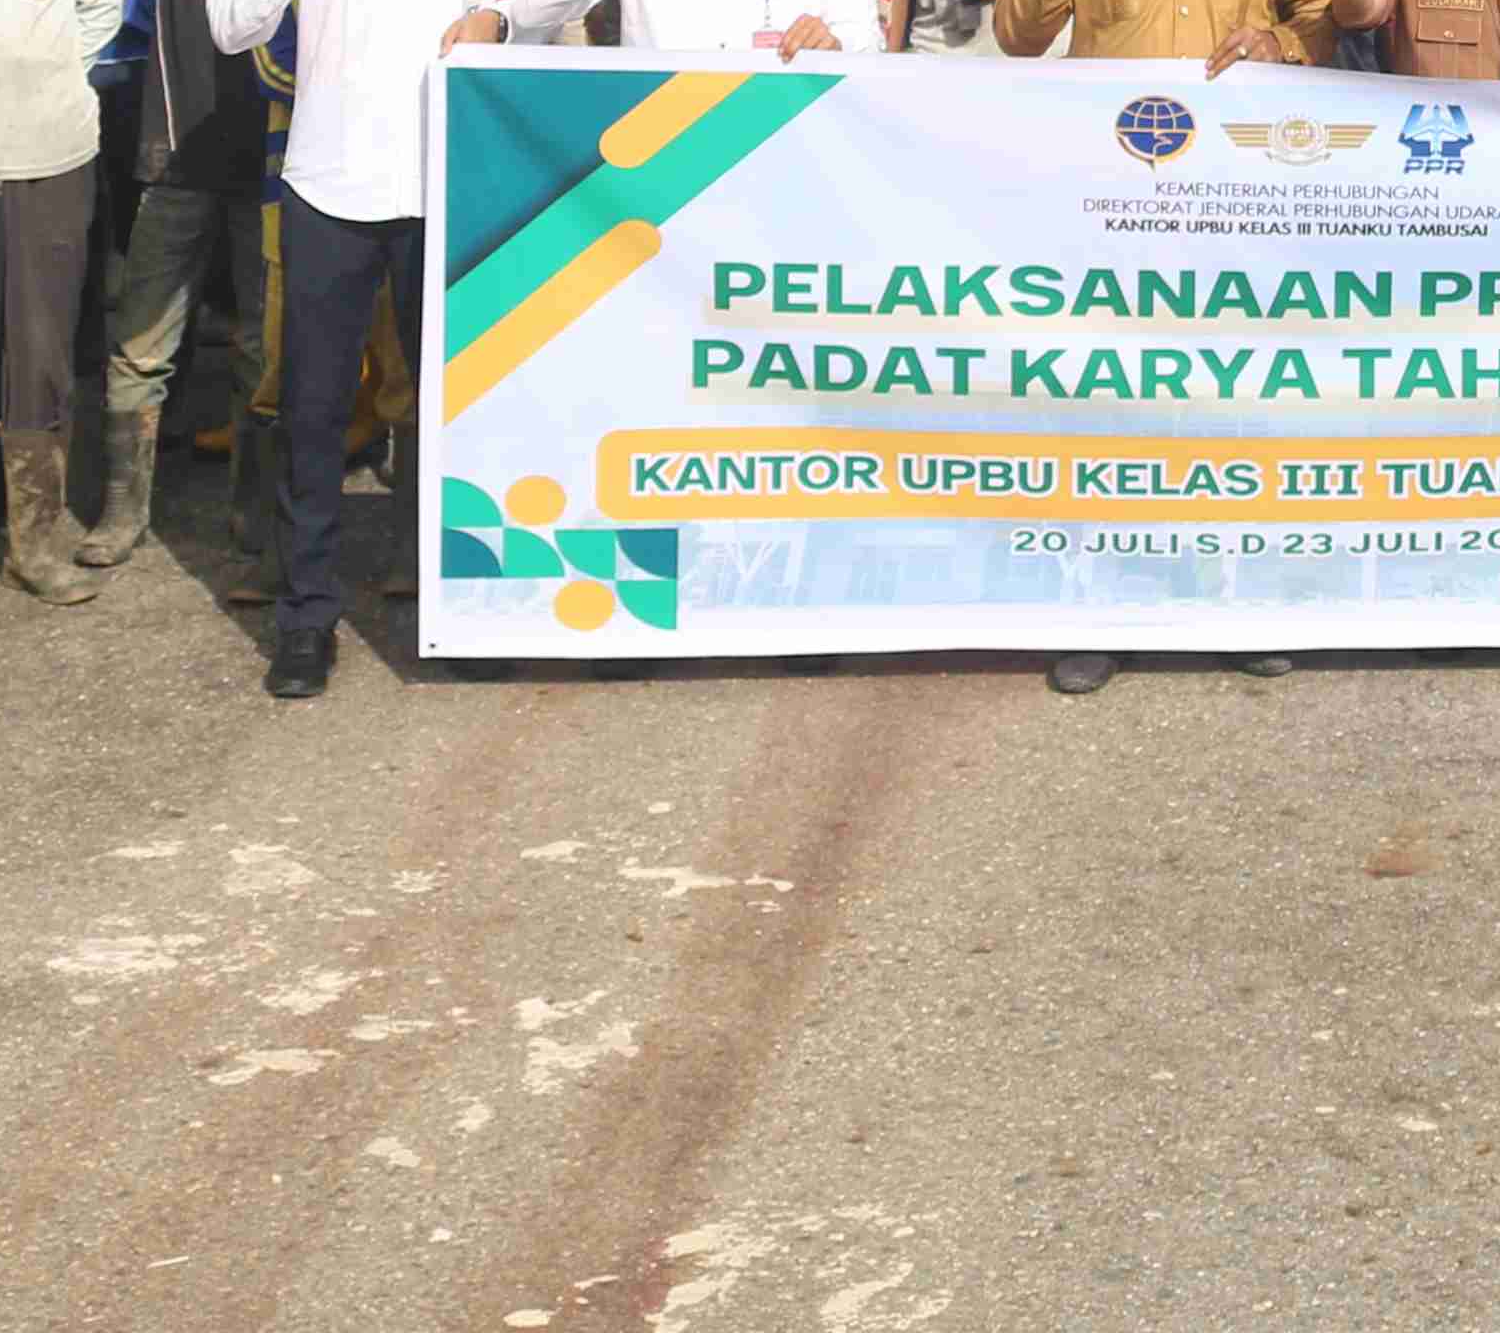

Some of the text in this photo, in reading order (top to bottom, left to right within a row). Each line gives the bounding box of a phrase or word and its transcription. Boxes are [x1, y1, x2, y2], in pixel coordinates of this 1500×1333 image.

[1403, 158, 1465, 175] PPR
[1155, 181, 1440, 201] KEMENTERIAN PERHUBUNGAN
[1083, 197, 1196, 216] DIREKTORAT
[1198, 200, 1288, 219] JENDERAL
[1293, 202, 1442, 220] PERHUBUNGAN
[1104, 217, 1490, 238] KANTOR UPBU KELAS III TUANKU TAMBUSAI
[712, 261, 1393, 320] PELAKSANAAN
[691, 338, 988, 396] PADAT
[1010, 347, 1320, 400] KARYA
[632, 453, 881, 494] KANTOR
[901, 456, 1055, 495] UPBU
[1075, 460, 1261, 498] KELAS
[1280, 462, 1360, 497] III
[1012, 528, 1069, 553] 20
[1084, 531, 1181, 556] JULI
[1195, 531, 1268, 556] S.D
[1281, 532, 1334, 555] 23
[1349, 530, 1444, 554] JULI
